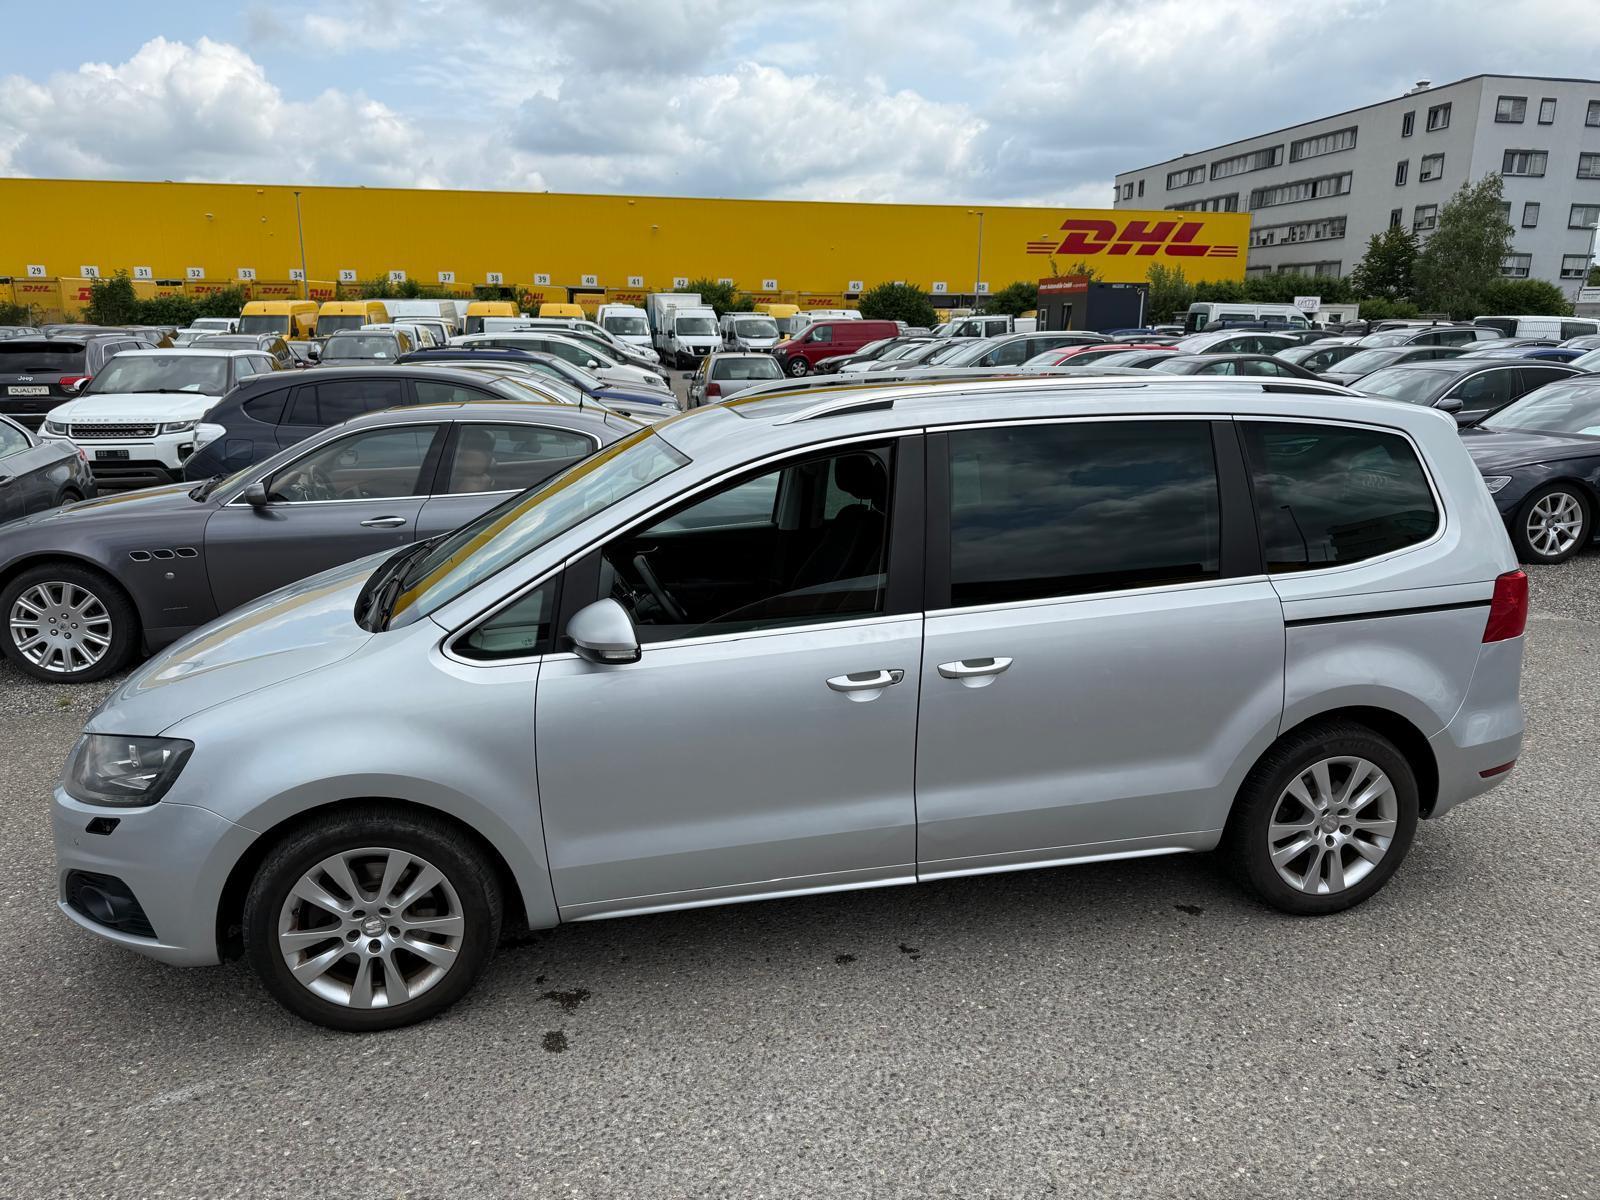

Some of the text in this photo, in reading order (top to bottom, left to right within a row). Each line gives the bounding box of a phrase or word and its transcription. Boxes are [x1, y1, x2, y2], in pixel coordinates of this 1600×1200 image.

[1055, 219, 1209, 257] DHL
[31, 267, 42, 275] 29
[84, 268, 95, 276] 30
[139, 268, 148, 276] 31
[191, 269, 201, 277] 32
[242, 270, 252, 278] 33
[293, 271, 303, 279] 34
[442, 273, 451, 281] 37
[537, 275, 547, 283] 39
[585, 276, 595, 284] 40
[676, 279, 685, 287] 42
[808, 298, 834, 306] DHL
